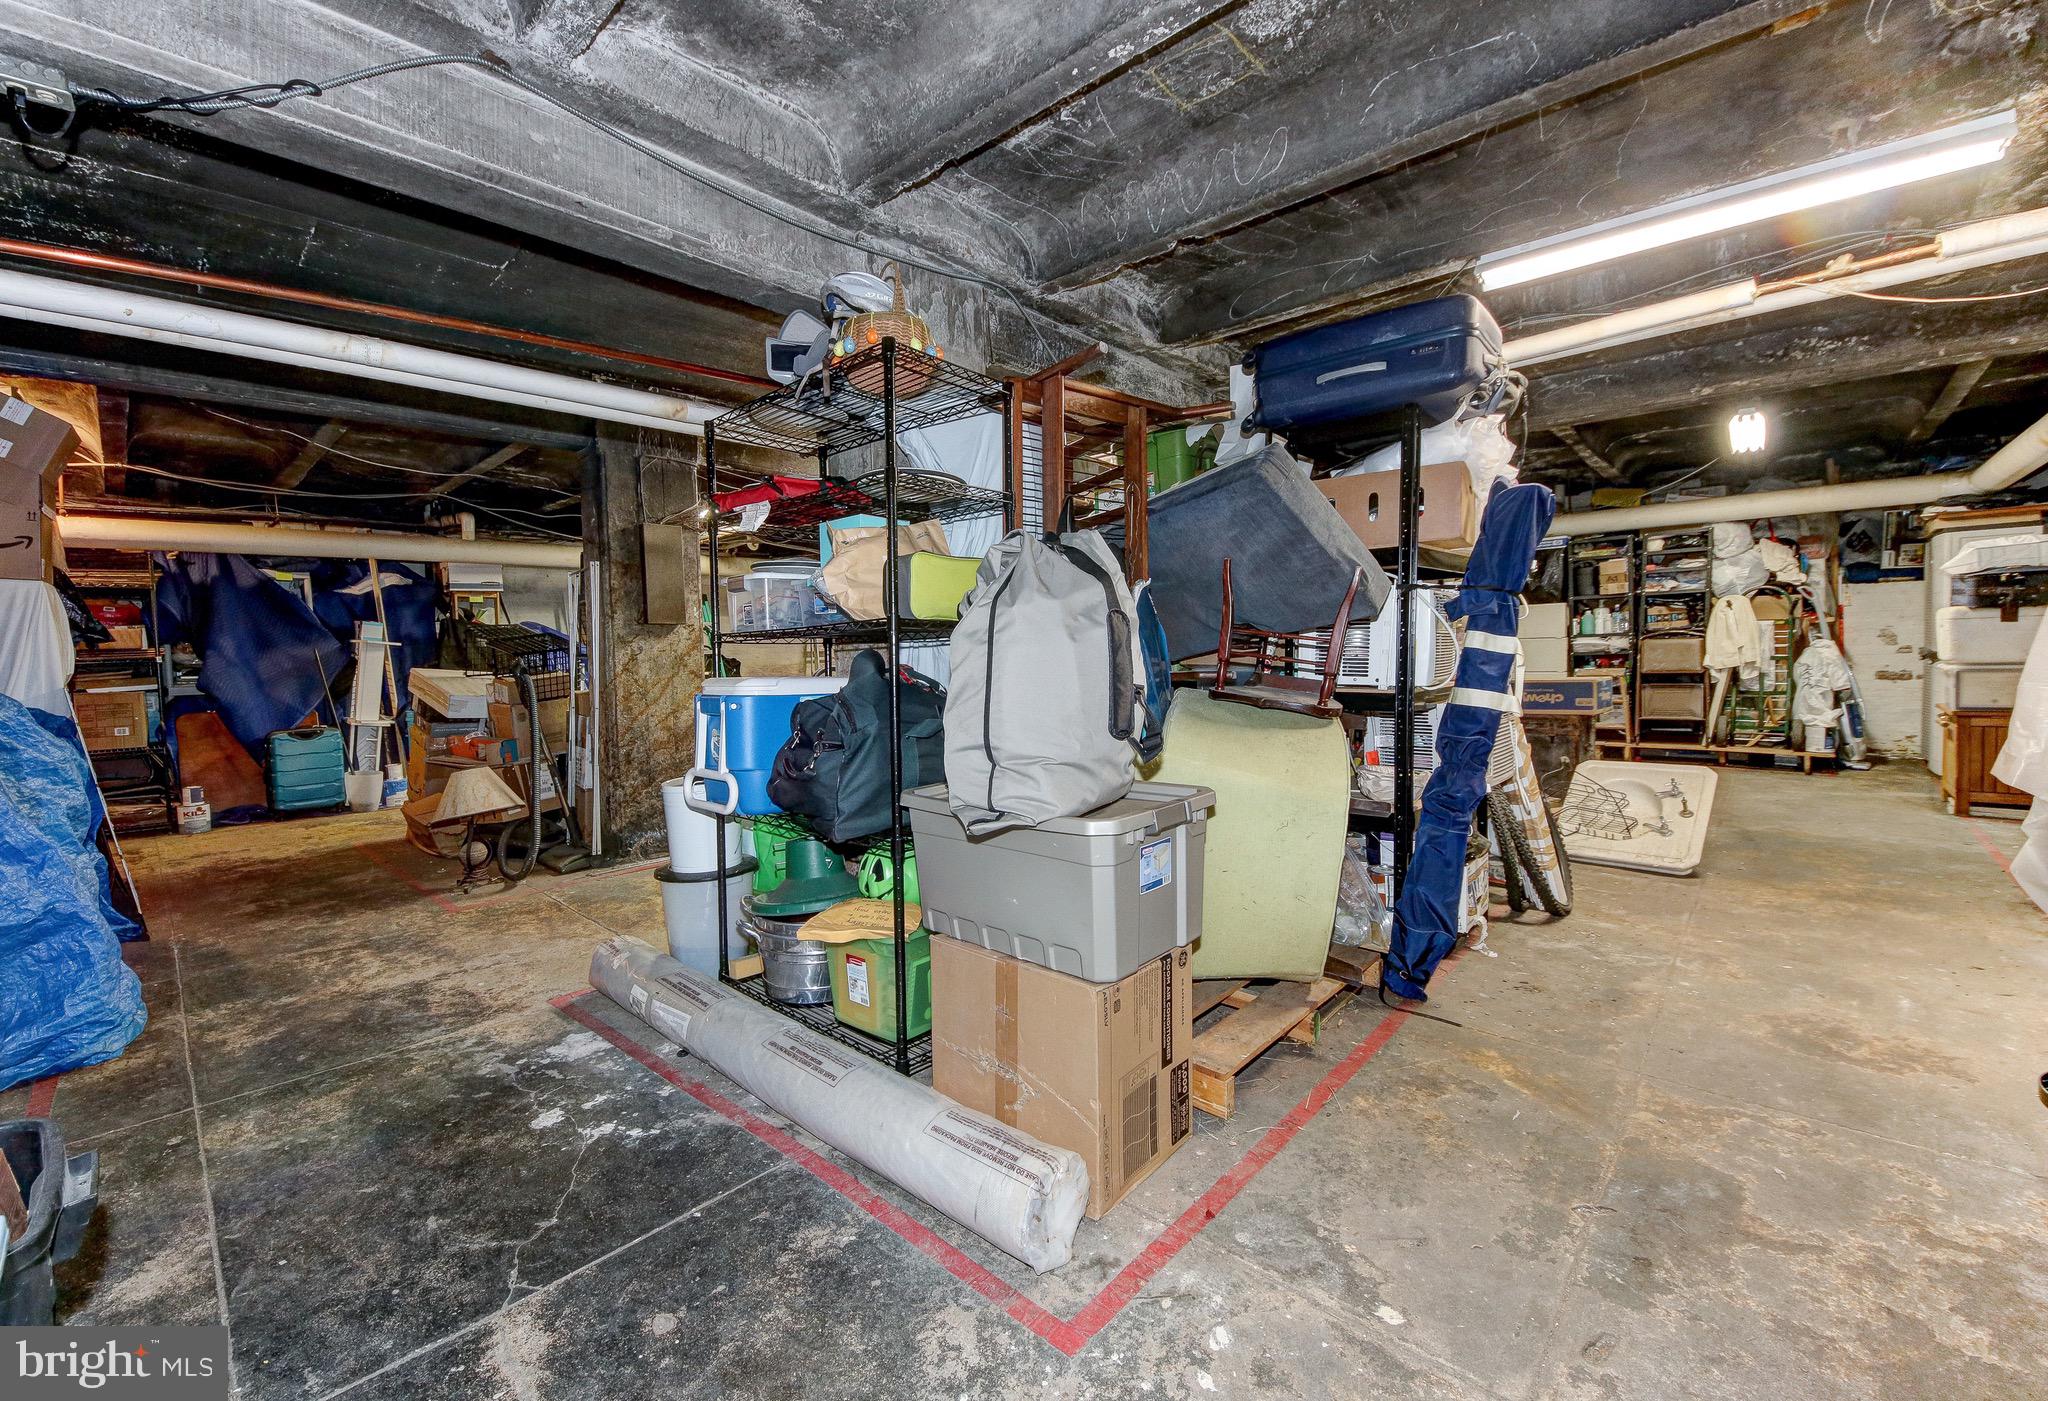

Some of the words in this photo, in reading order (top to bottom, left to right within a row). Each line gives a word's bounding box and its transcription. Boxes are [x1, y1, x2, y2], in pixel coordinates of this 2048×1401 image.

[931, 1125, 958, 1144] PACKAGING
[958, 1138, 971, 1150] FROM
[971, 1144, 982, 1155] RUG
[983, 1150, 1004, 1166] REMOVE
[997, 1149, 1019, 1161] BEFORE
[1005, 1162, 1016, 1171] NOT
[1016, 1167, 1025, 1176] DO
